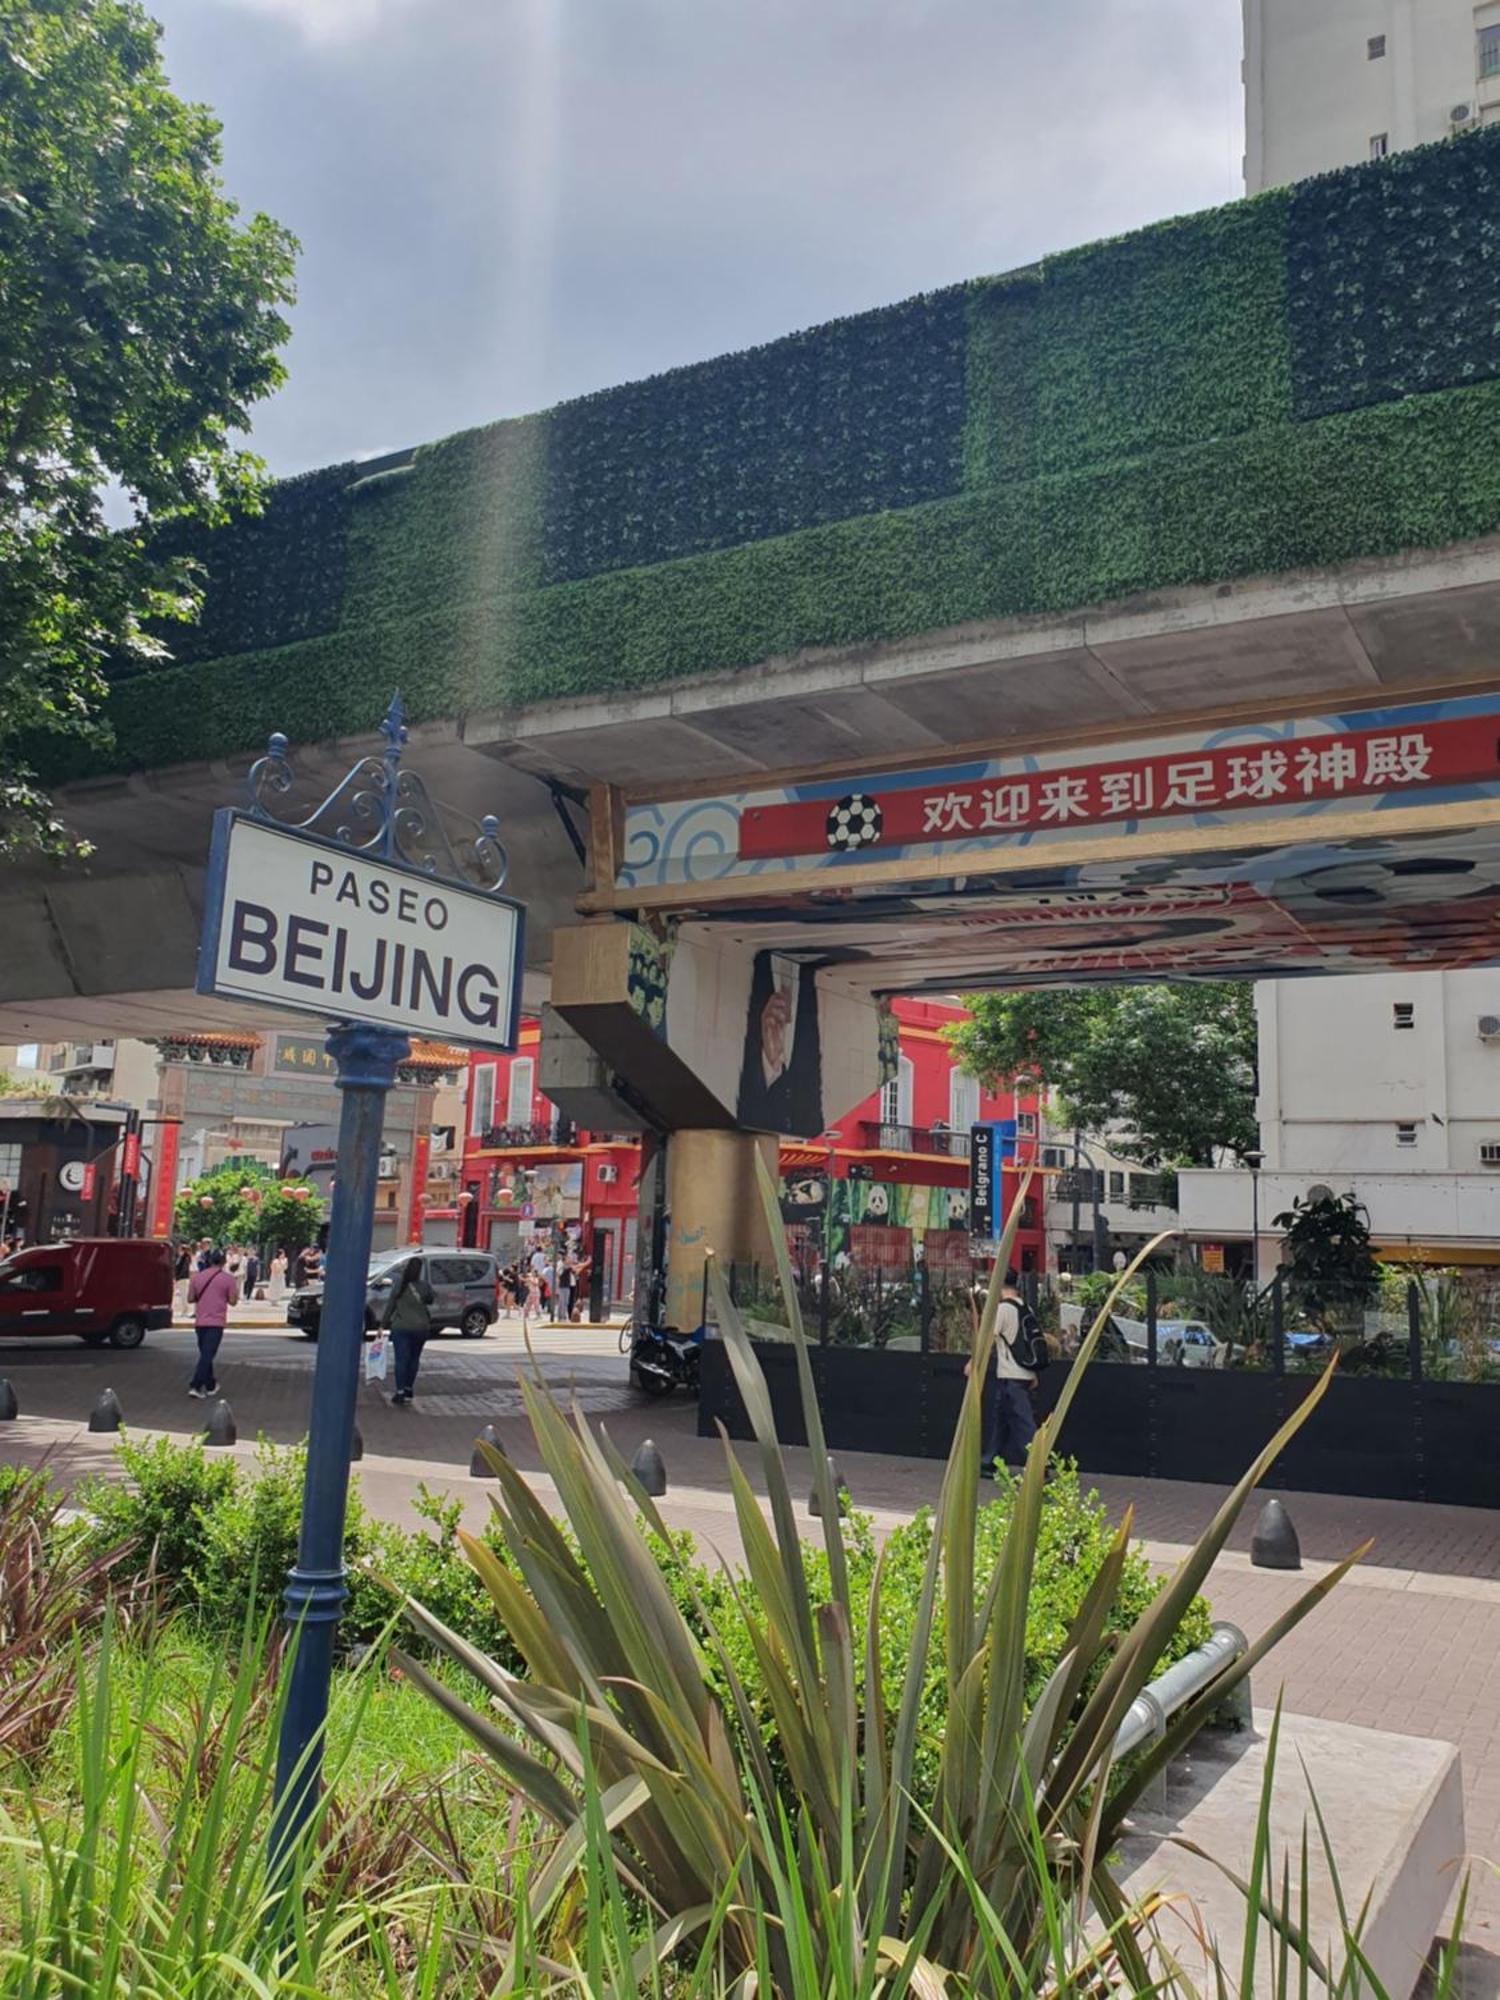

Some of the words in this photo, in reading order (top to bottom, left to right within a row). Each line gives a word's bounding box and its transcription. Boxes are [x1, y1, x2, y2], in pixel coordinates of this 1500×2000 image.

[922, 733, 1433, 833] 欢迎来到足球神殿
[310, 860, 448, 931] PASEO
[228, 899, 500, 1029] BEIJING
[975, 1133, 988, 1143] C
[975, 1146, 990, 1206] Belgrano
